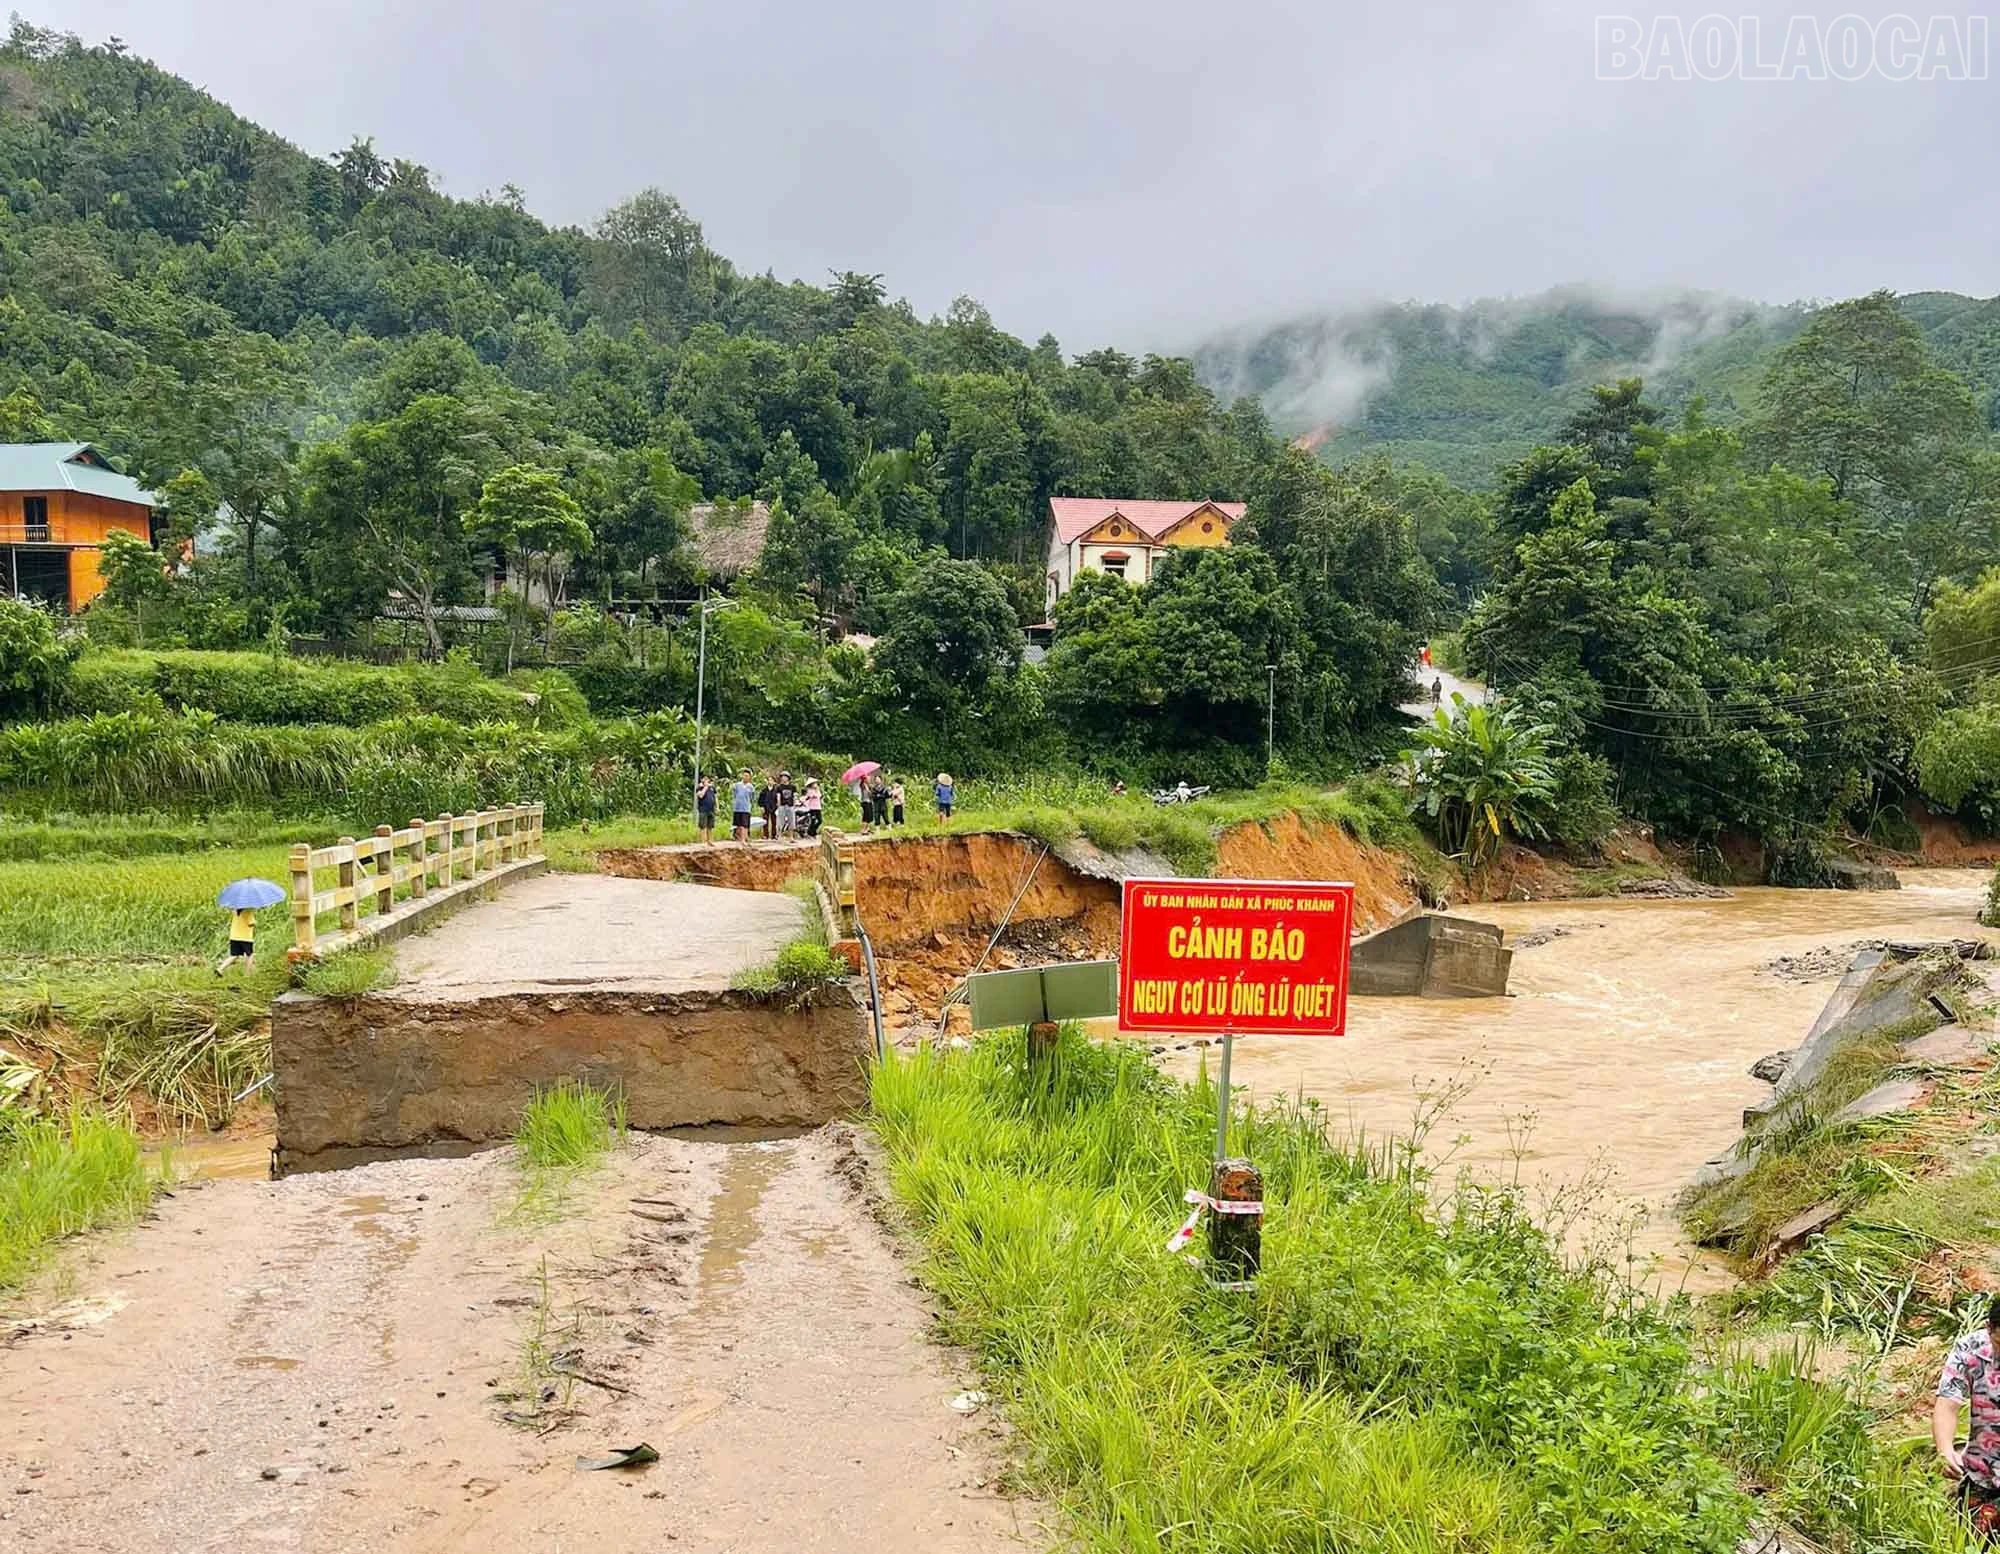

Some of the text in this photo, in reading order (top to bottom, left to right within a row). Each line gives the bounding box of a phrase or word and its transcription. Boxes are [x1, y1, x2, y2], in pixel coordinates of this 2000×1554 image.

[1144, 892, 1334, 912] ỦY BAN NHÂN DÂN XÃ PHÚC KHÁNH
[1168, 916, 1305, 961] CẢNH BÁO
[1133, 970, 1334, 1020] NGUY CƠ LŨ ỐNG LŨ QUÉT
